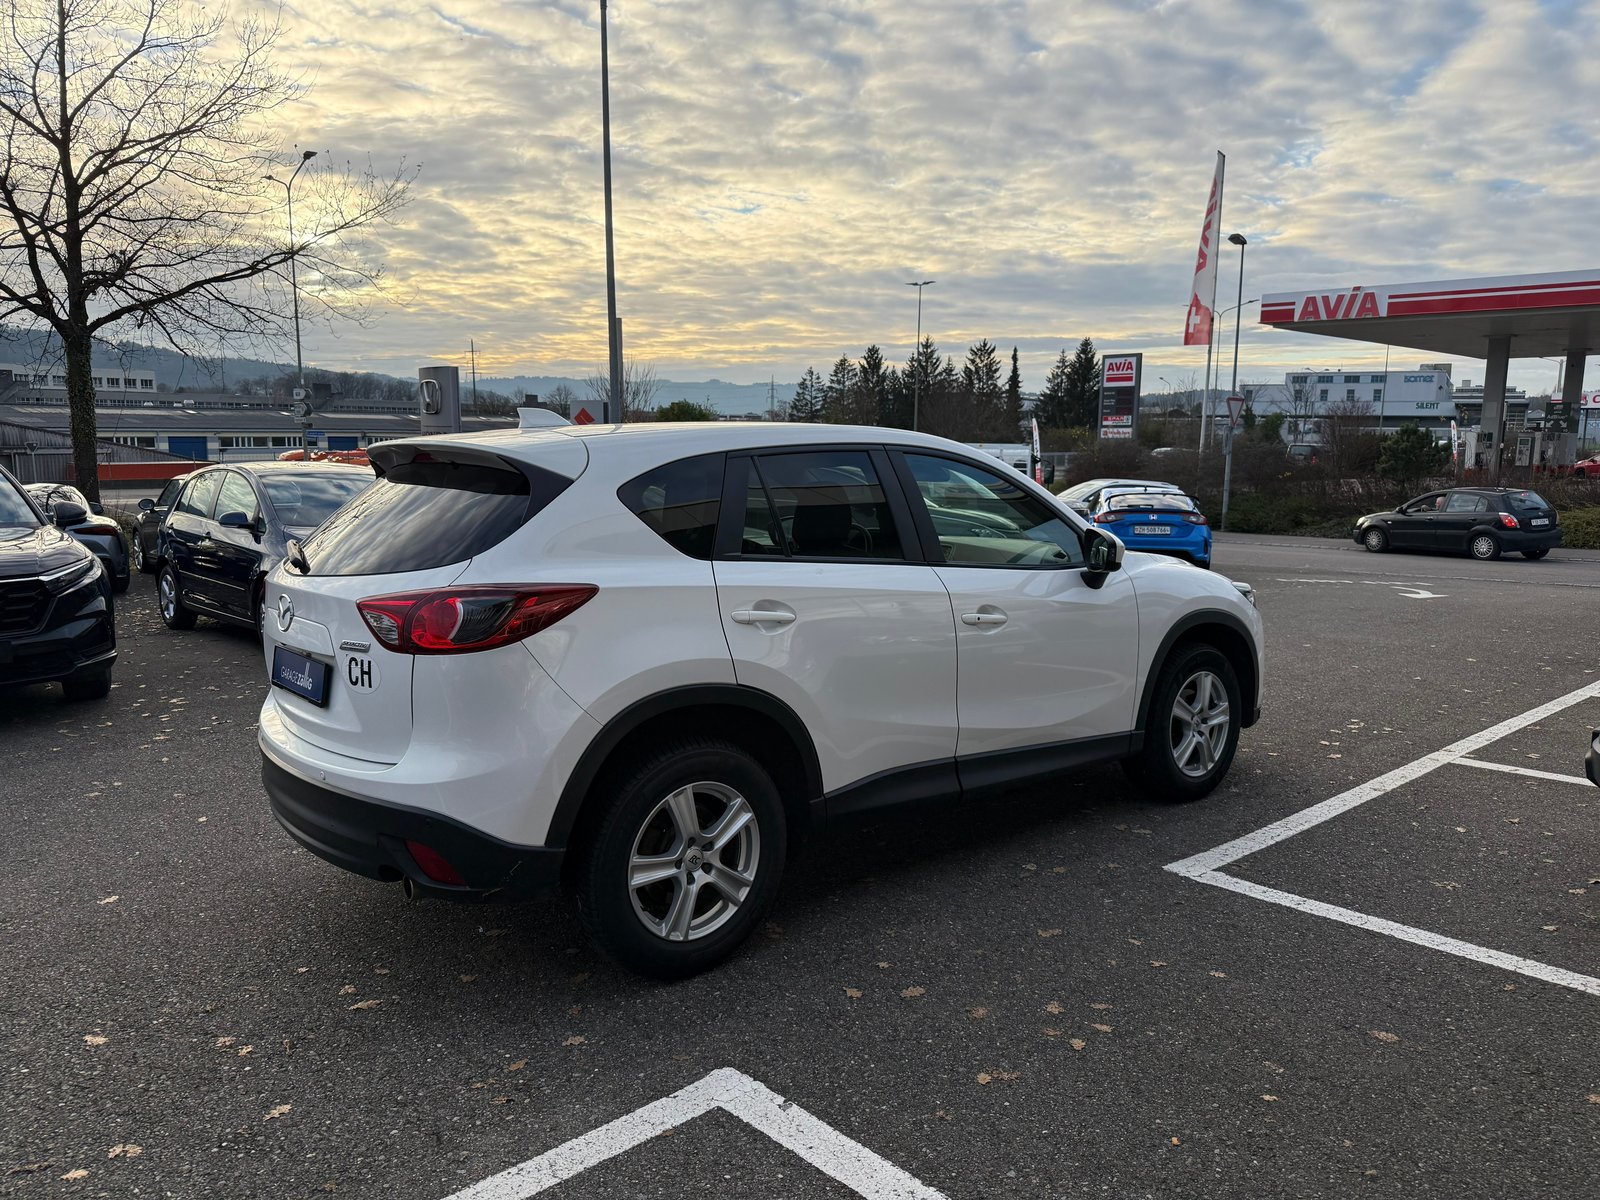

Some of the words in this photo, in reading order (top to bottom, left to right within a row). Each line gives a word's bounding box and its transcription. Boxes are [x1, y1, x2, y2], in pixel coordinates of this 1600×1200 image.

[1298, 286, 1380, 320] AVIA
[1106, 359, 1134, 373] AVIA
[348, 656, 372, 688] CH
